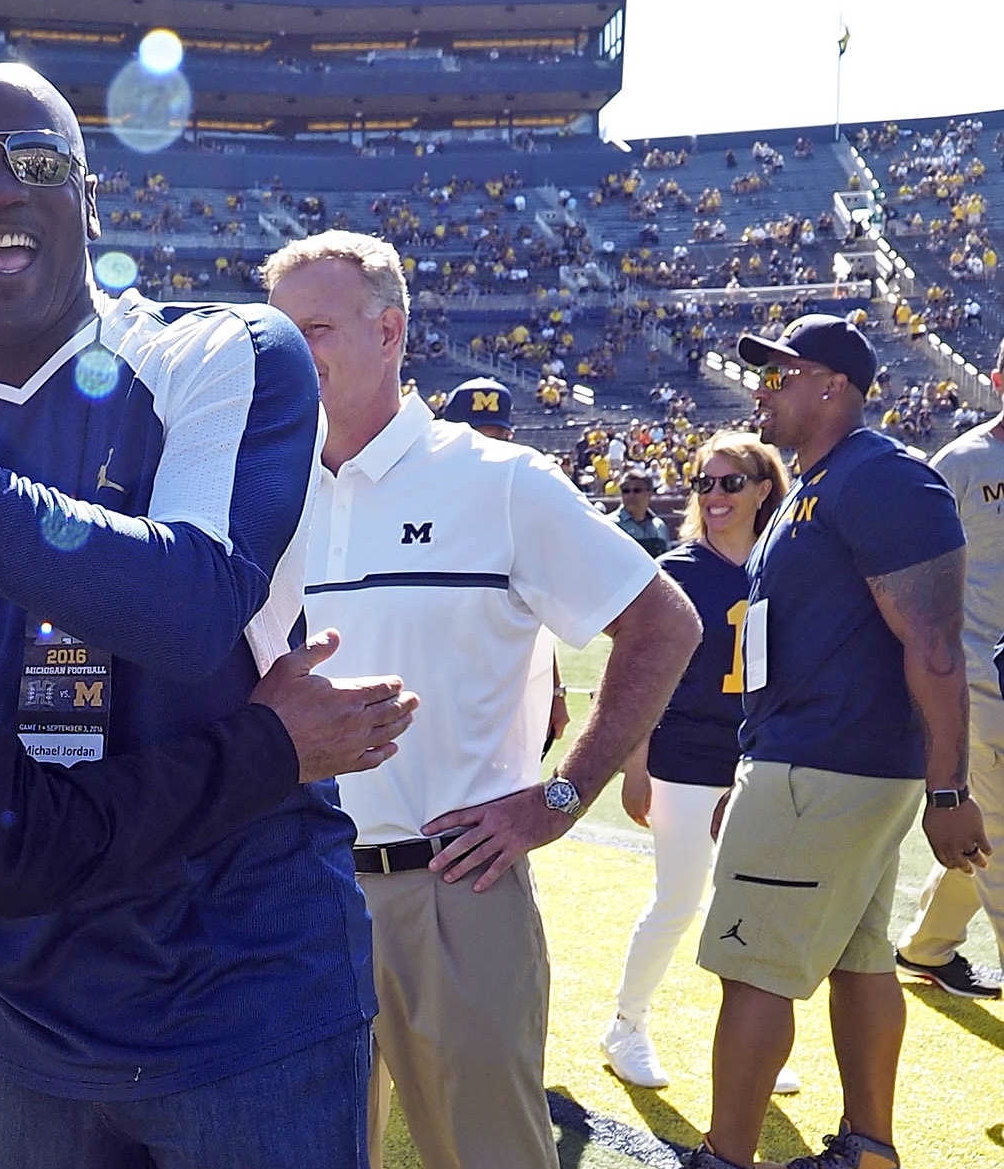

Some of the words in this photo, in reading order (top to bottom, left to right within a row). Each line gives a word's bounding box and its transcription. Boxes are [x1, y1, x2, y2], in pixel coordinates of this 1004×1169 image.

[472, 391, 499, 412] M
[401, 522, 433, 544] M
[47, 649, 87, 664] 2016
[722, 599, 749, 693] 1
[25, 666, 65, 675] MICHIGAN
[67, 666, 107, 675] FOOTBALL
[73, 681, 103, 707] M
[62, 746, 95, 756] Jordan
